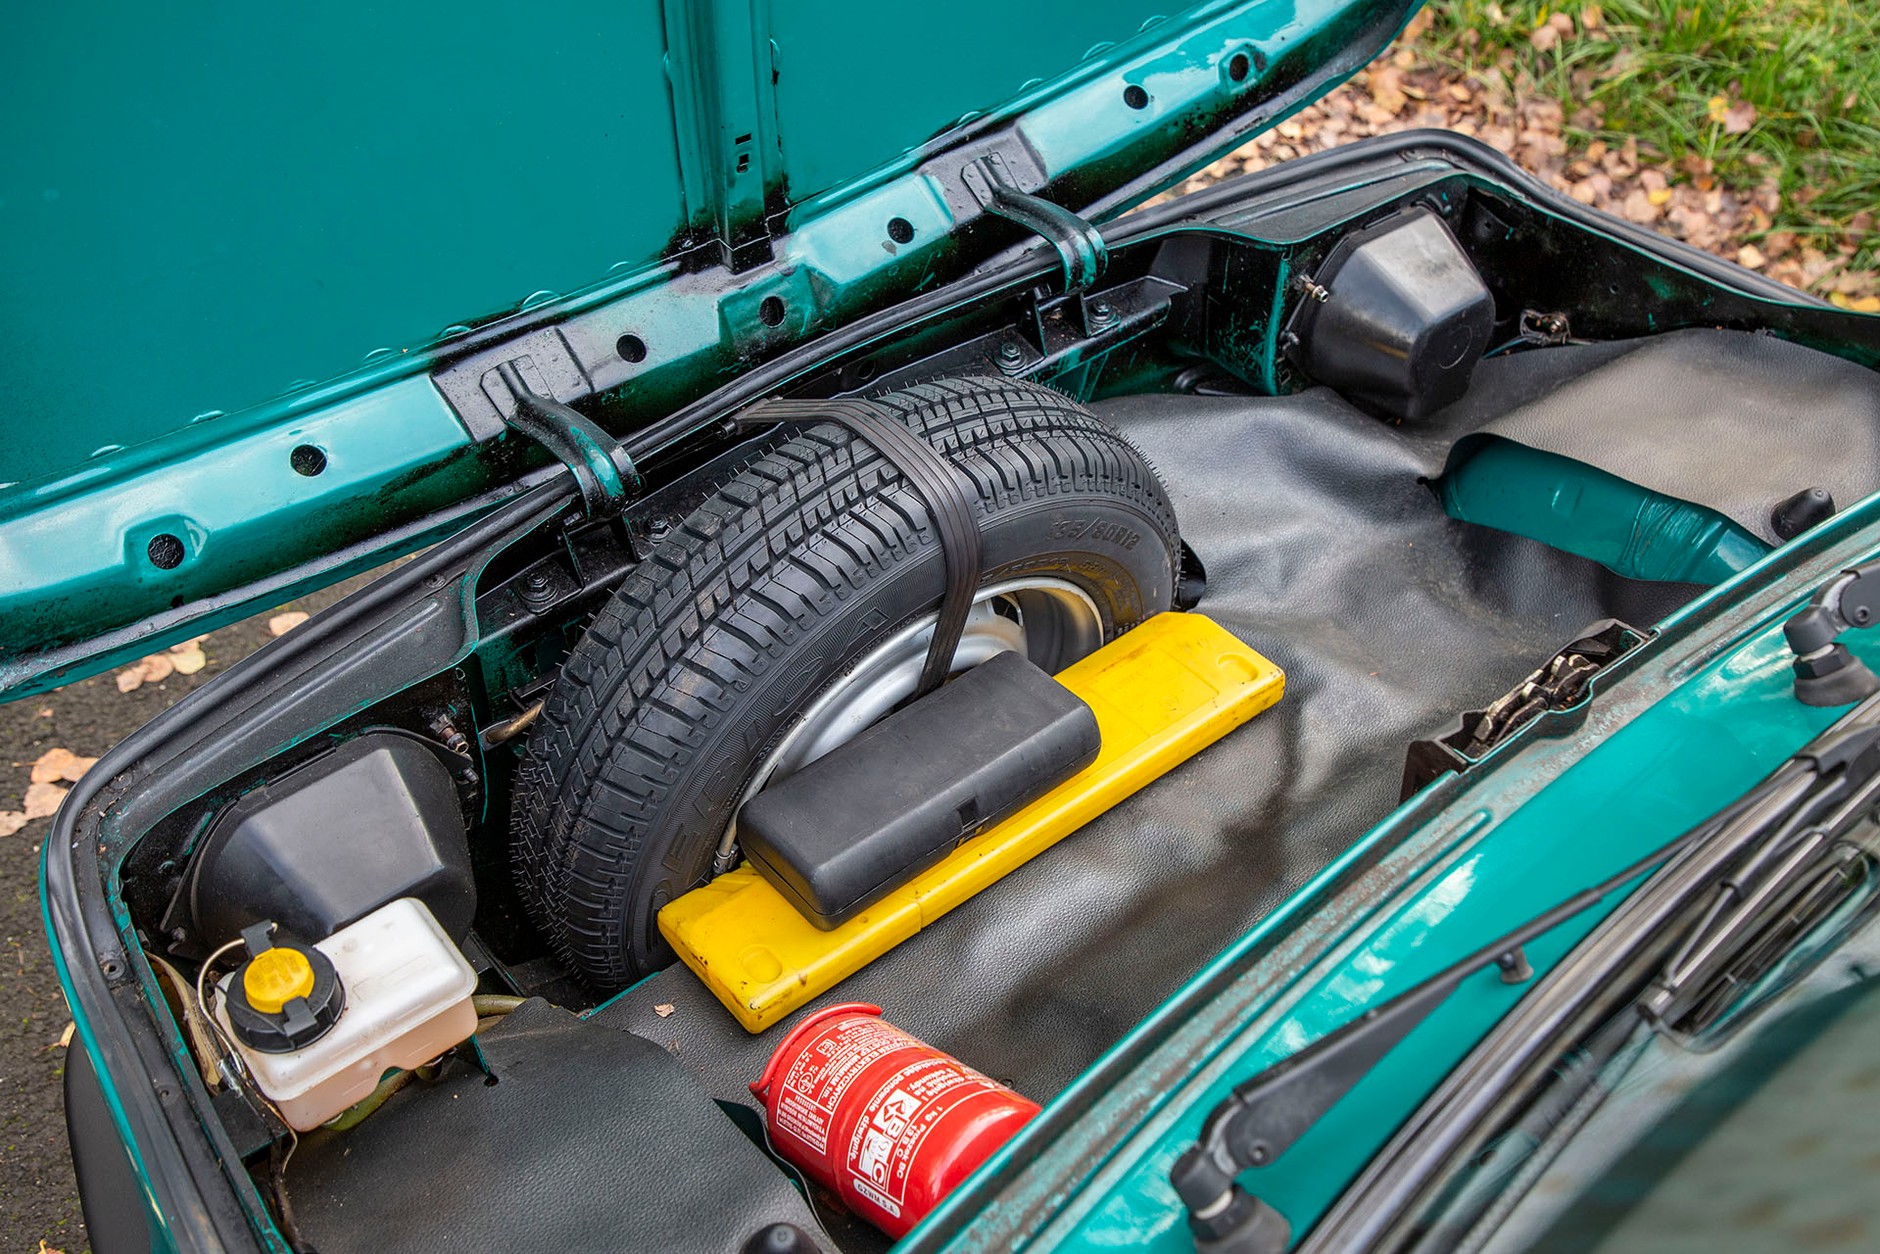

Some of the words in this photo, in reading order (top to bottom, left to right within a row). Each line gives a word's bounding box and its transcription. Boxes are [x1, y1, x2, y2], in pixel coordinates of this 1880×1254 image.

[827, 1051, 880, 1110] ELEKTRYCZNYCH
[830, 1054, 861, 1086] MINIMUM
[869, 1074, 904, 1112] ponownie
[925, 1111, 938, 1121] kg
[886, 1117, 904, 1137] B
[874, 1162, 887, 1183] C
[897, 1162, 906, 1178] BC
